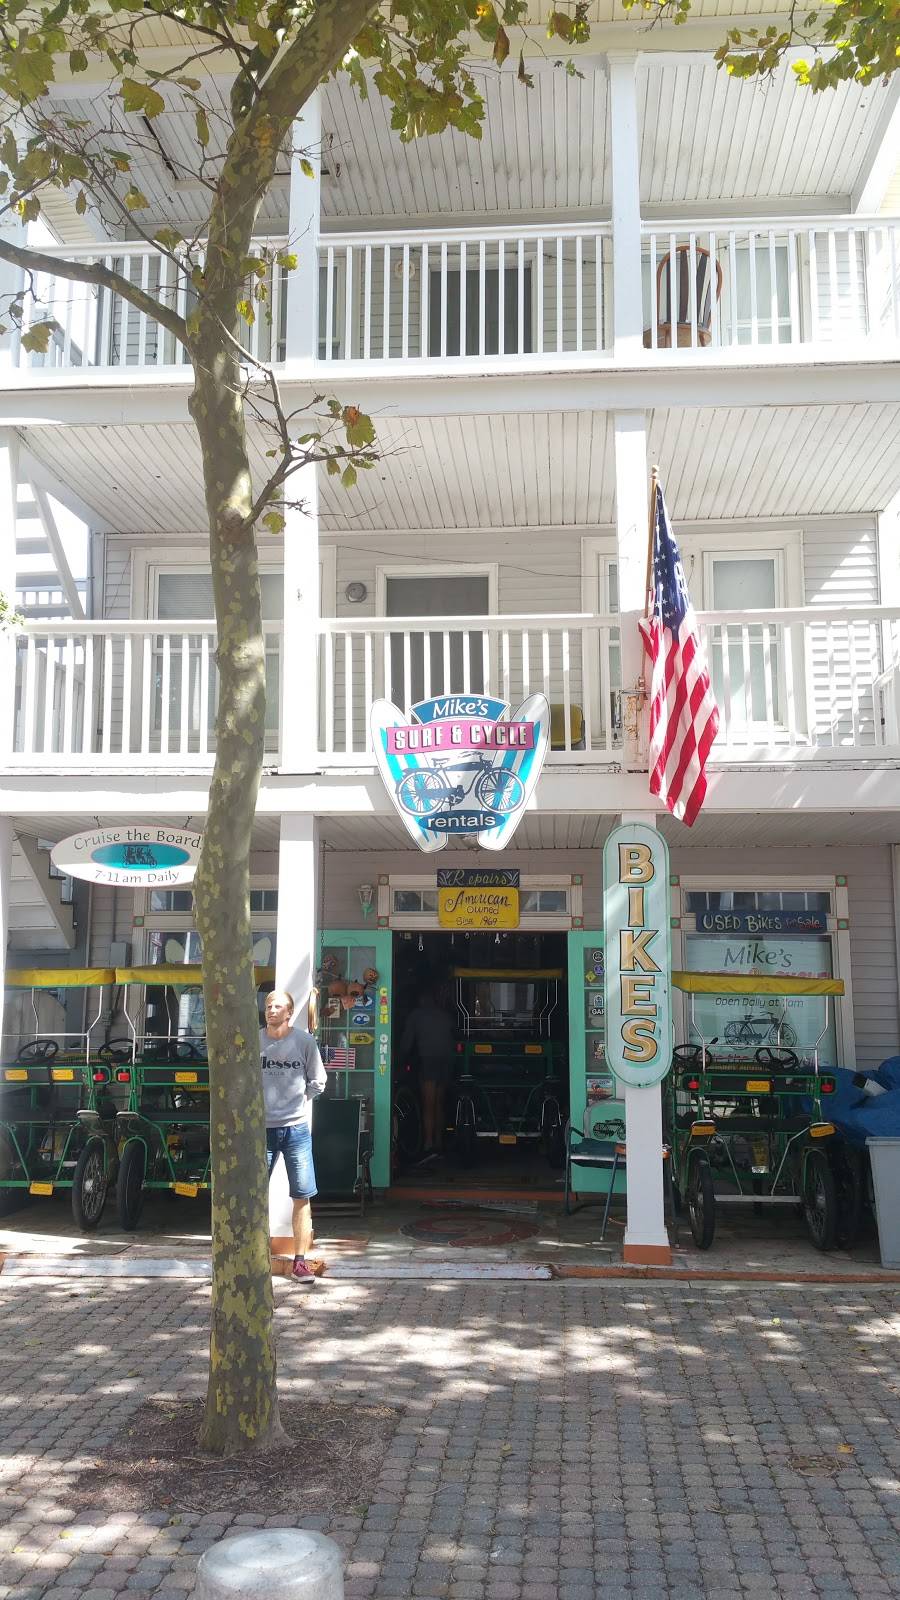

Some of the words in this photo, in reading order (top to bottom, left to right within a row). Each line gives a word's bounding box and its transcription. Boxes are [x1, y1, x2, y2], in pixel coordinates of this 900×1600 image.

[433, 700, 489, 718] Mike's
[395, 727, 443, 749] SURF
[451, 725, 463, 745] &
[470, 725, 527, 745] CYCLE
[427, 814, 496, 828] rentals
[74, 832, 121, 850] Cruise
[127, 829, 150, 841] the
[147, 870, 180, 883] Daily
[450, 870, 507, 886] Repairs
[703, 914, 741, 931] USED
[618, 842, 662, 1063] BIKES
[724, 943, 793, 968] Mike's
[742, 997, 766, 1008] Daily
[768, 998, 780, 1007] at
[261, 1056, 301, 1069] lesse
